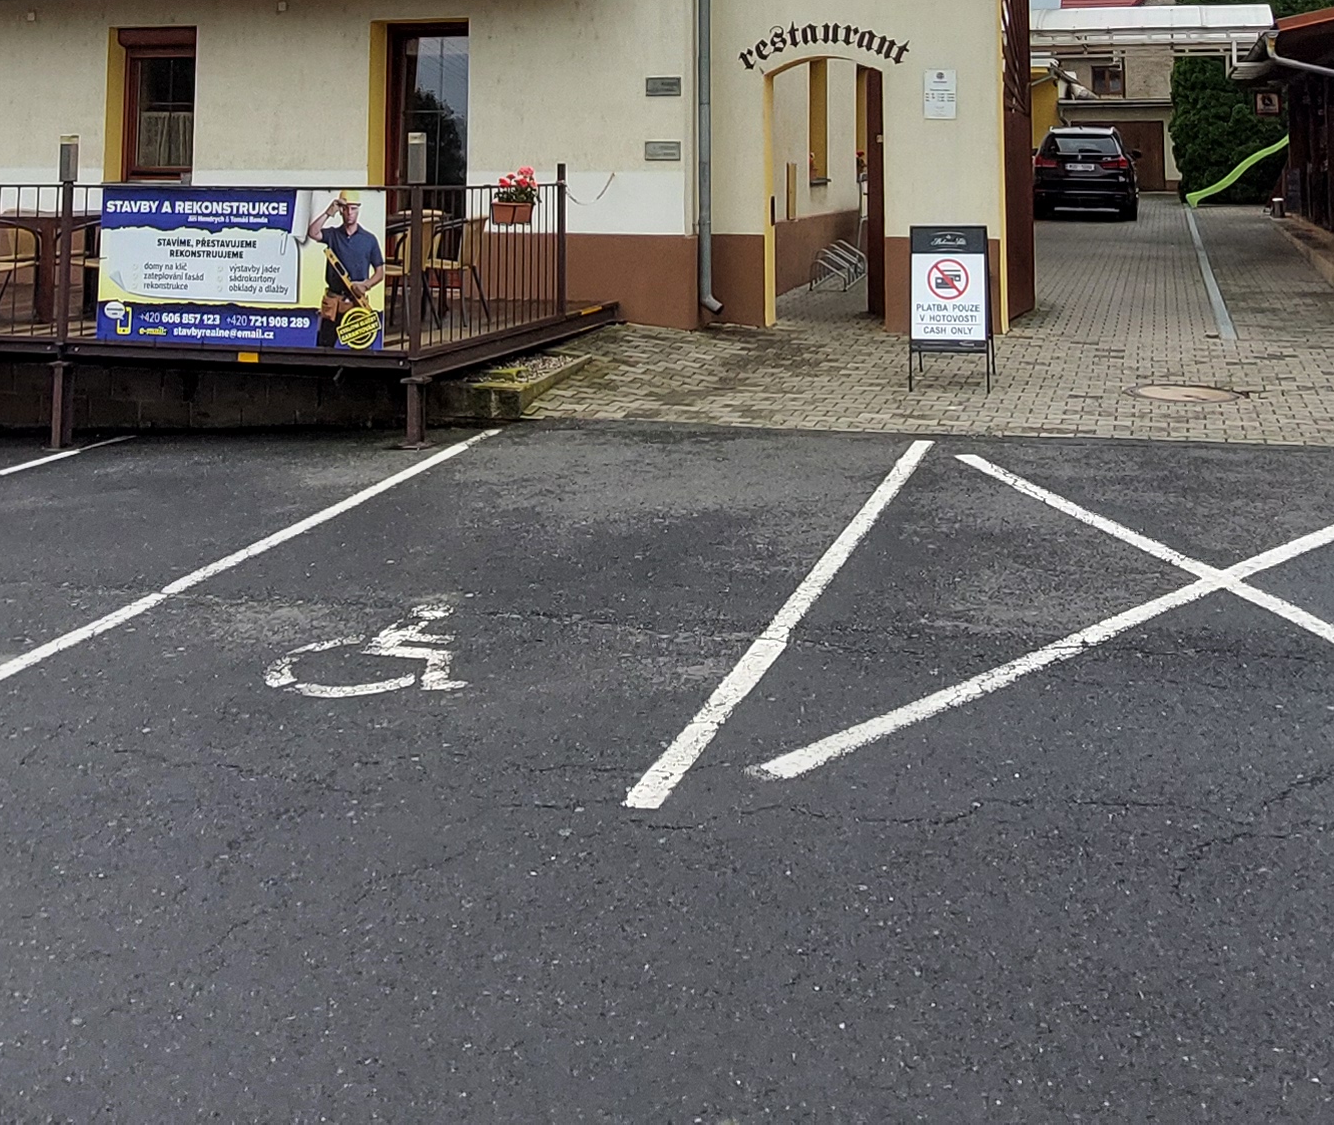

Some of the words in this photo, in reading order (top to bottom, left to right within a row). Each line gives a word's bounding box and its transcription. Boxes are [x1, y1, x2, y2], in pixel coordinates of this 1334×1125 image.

[738, 21, 910, 70] restaurant
[106, 200, 160, 214] STAVBY
[160, 201, 173, 214] A
[175, 201, 288, 216] REKONSTRUKCE
[195, 236, 257, 249] PŘESTAVUJEME
[169, 249, 244, 259] REKONSTRUUJEME
[144, 262, 164, 272] domy
[164, 263, 174, 271] na
[229, 263, 260, 275] výstavby
[260, 264, 281, 275] jader
[143, 281, 189, 291] rekonstrukce
[228, 283, 258, 295] obklady
[916, 303, 949, 312] PLATBA
[952, 303, 980, 313] POUZE
[139, 312, 160, 323] +420
[161, 312, 181, 324] 606
[181, 313, 201, 325] 857
[202, 313, 221, 325] 123
[226, 315, 247, 326] +420
[248, 316, 267, 327] 721
[268, 316, 288, 328] 908
[289, 317, 310, 329] 289
[919, 314, 926, 322] V
[929, 314, 977, 323] HOTOVOSTI
[923, 326, 947, 335] CASH
[950, 326, 973, 335] ONLY
